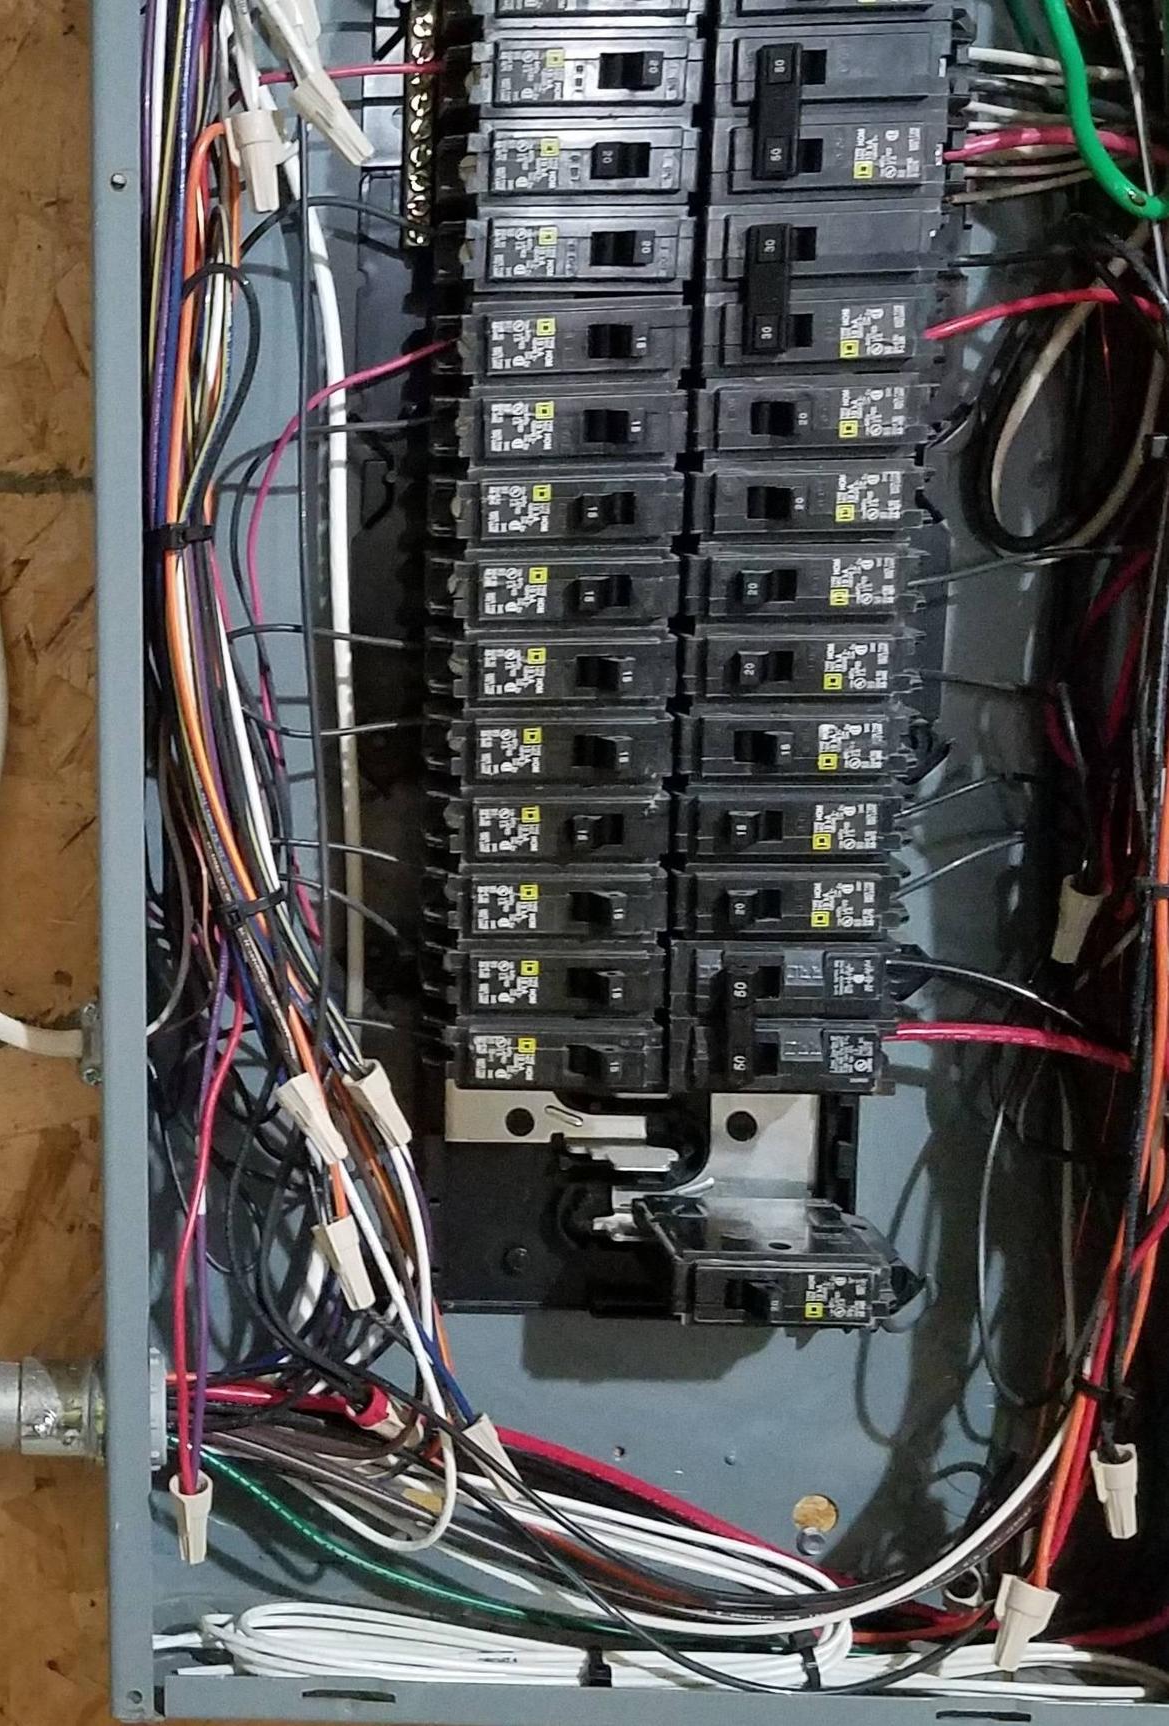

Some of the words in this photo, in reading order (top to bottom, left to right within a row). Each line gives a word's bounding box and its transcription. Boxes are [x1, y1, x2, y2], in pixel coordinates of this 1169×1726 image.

[763, 238, 777, 252] 30
[761, 326, 773, 340] 30
[797, 412, 809, 426] 20
[795, 497, 805, 510] 20
[747, 582, 759, 596] 20
[743, 663, 756, 676] 20
[734, 902, 747, 916] 20
